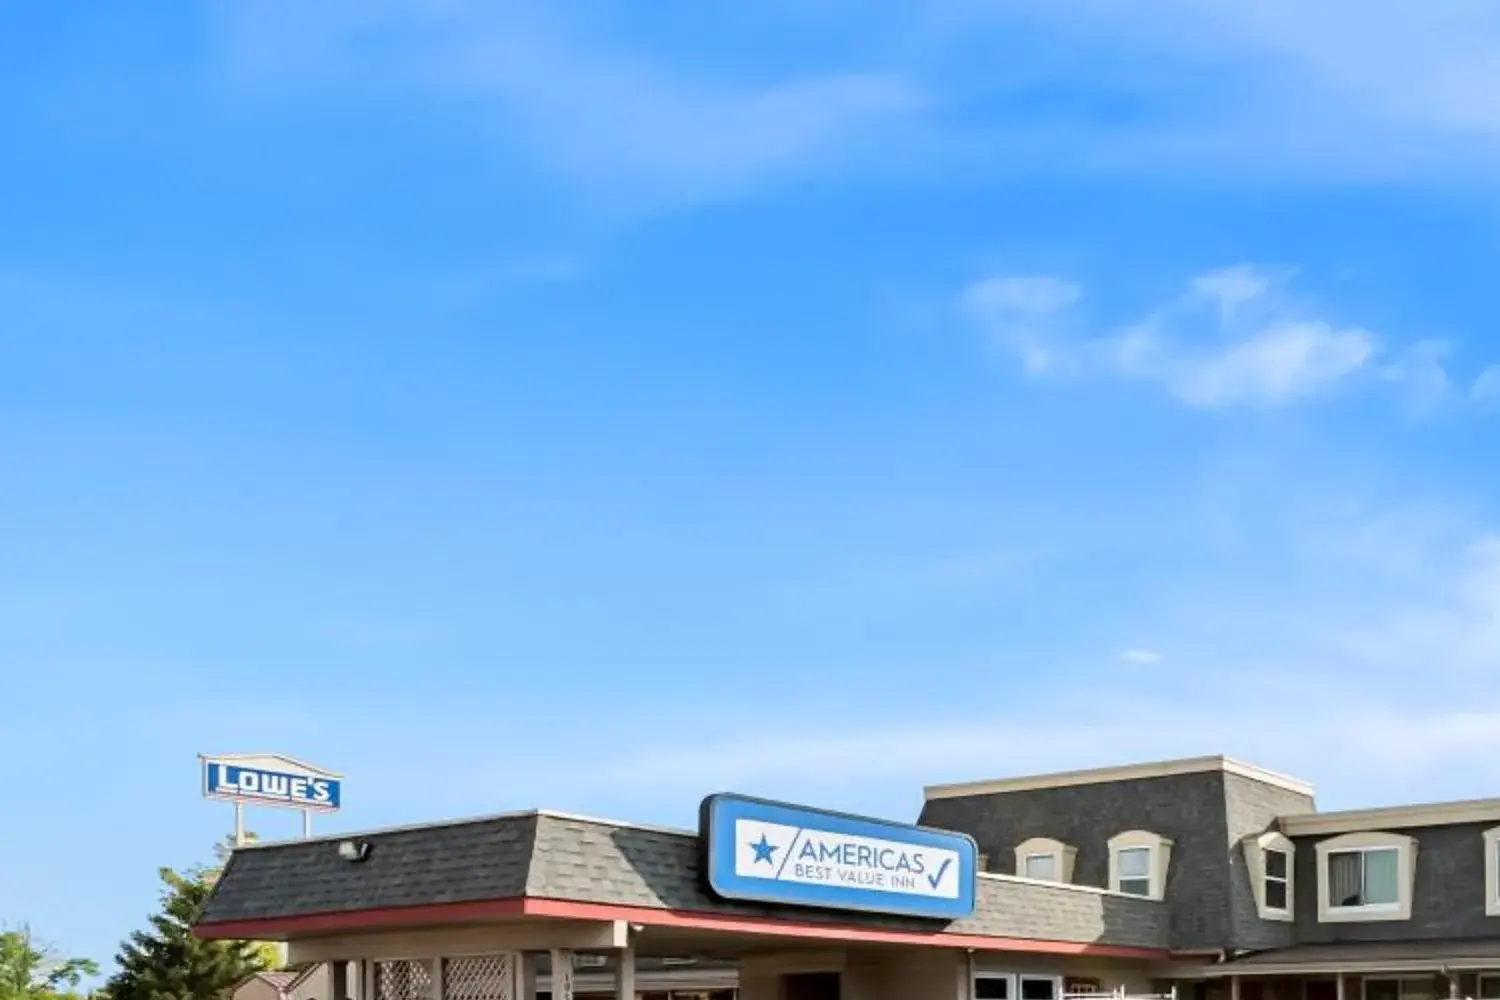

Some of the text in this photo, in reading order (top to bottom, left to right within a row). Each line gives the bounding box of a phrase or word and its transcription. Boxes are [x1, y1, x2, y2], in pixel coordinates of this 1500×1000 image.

[217, 766, 331, 801] LOWE'S
[799, 839, 924, 874] AMERICAS
[794, 863, 915, 888] BEST VALUE INN
